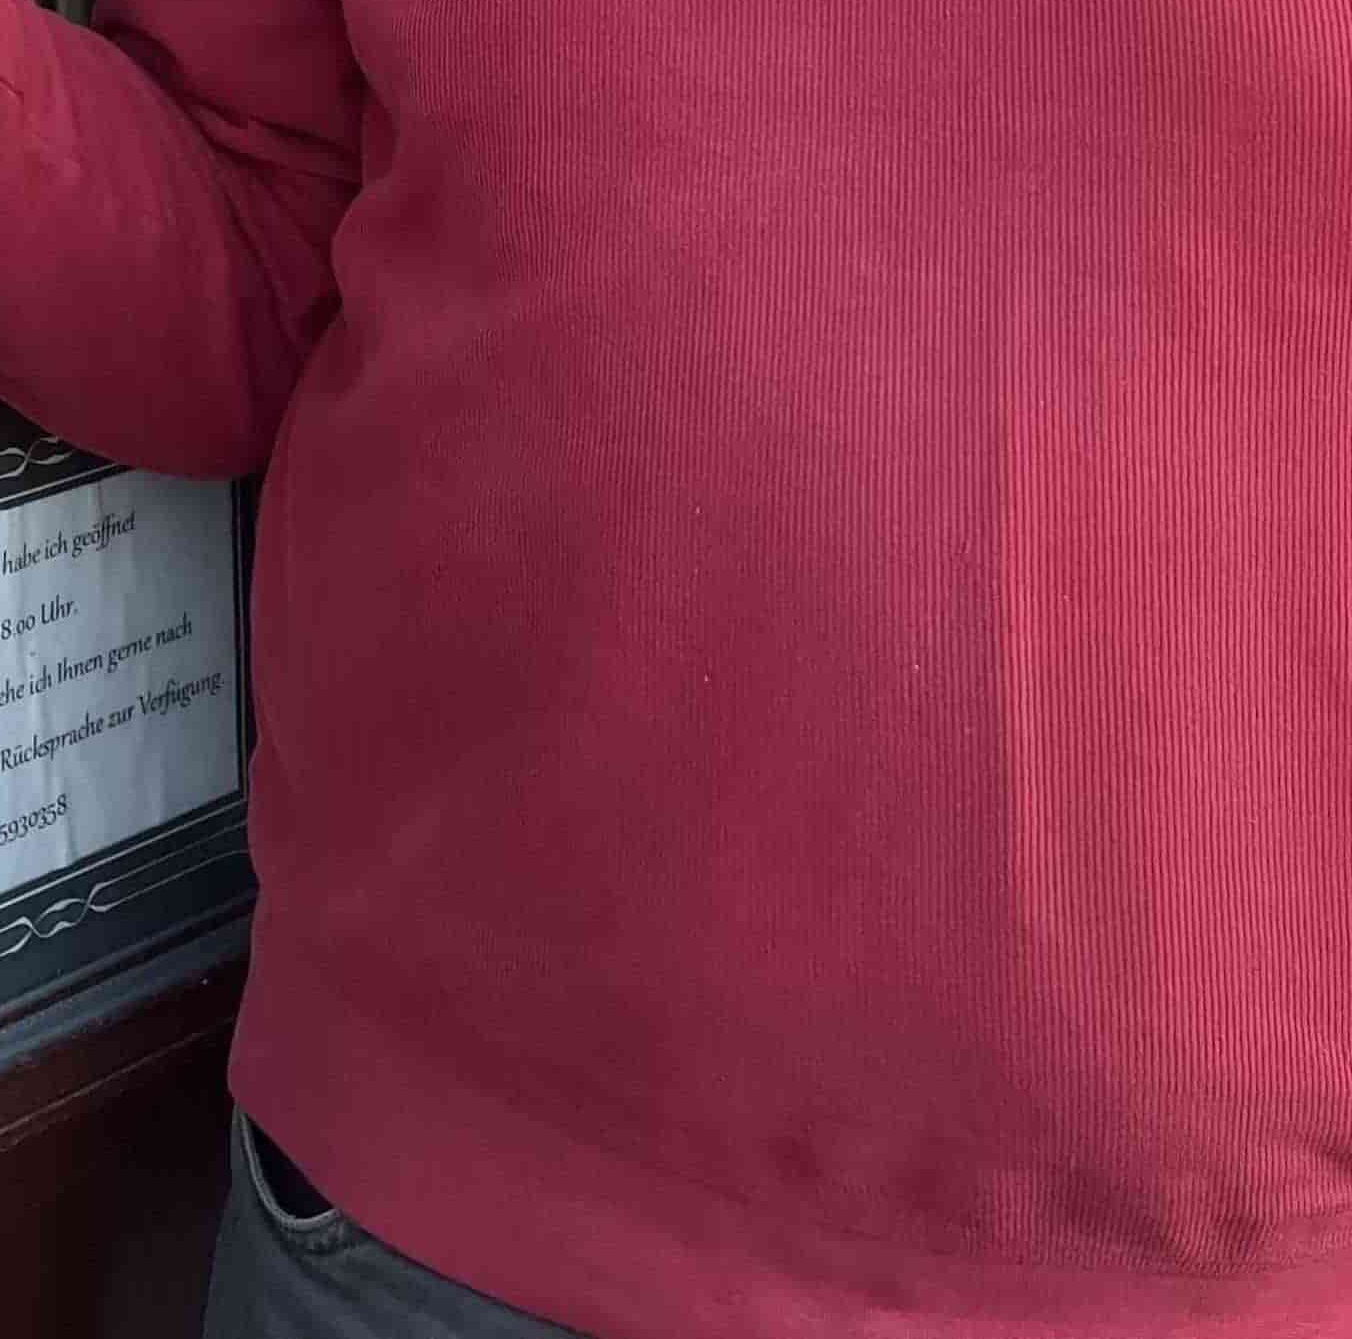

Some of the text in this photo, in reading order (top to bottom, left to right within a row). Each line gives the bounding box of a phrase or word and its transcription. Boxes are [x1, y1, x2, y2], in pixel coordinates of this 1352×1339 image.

[2, 542, 41, 574] habe
[45, 530, 68, 560] ich
[72, 510, 136, 558] geöffnet
[41, 593, 78, 625] Uhr.
[29, 665, 52, 695] ich
[57, 657, 103, 684] Ihnen
[107, 636, 152, 673] gerne
[156, 611, 192, 646] nach
[0, 710, 104, 772] Rücksprache
[107, 705, 135, 728] zur
